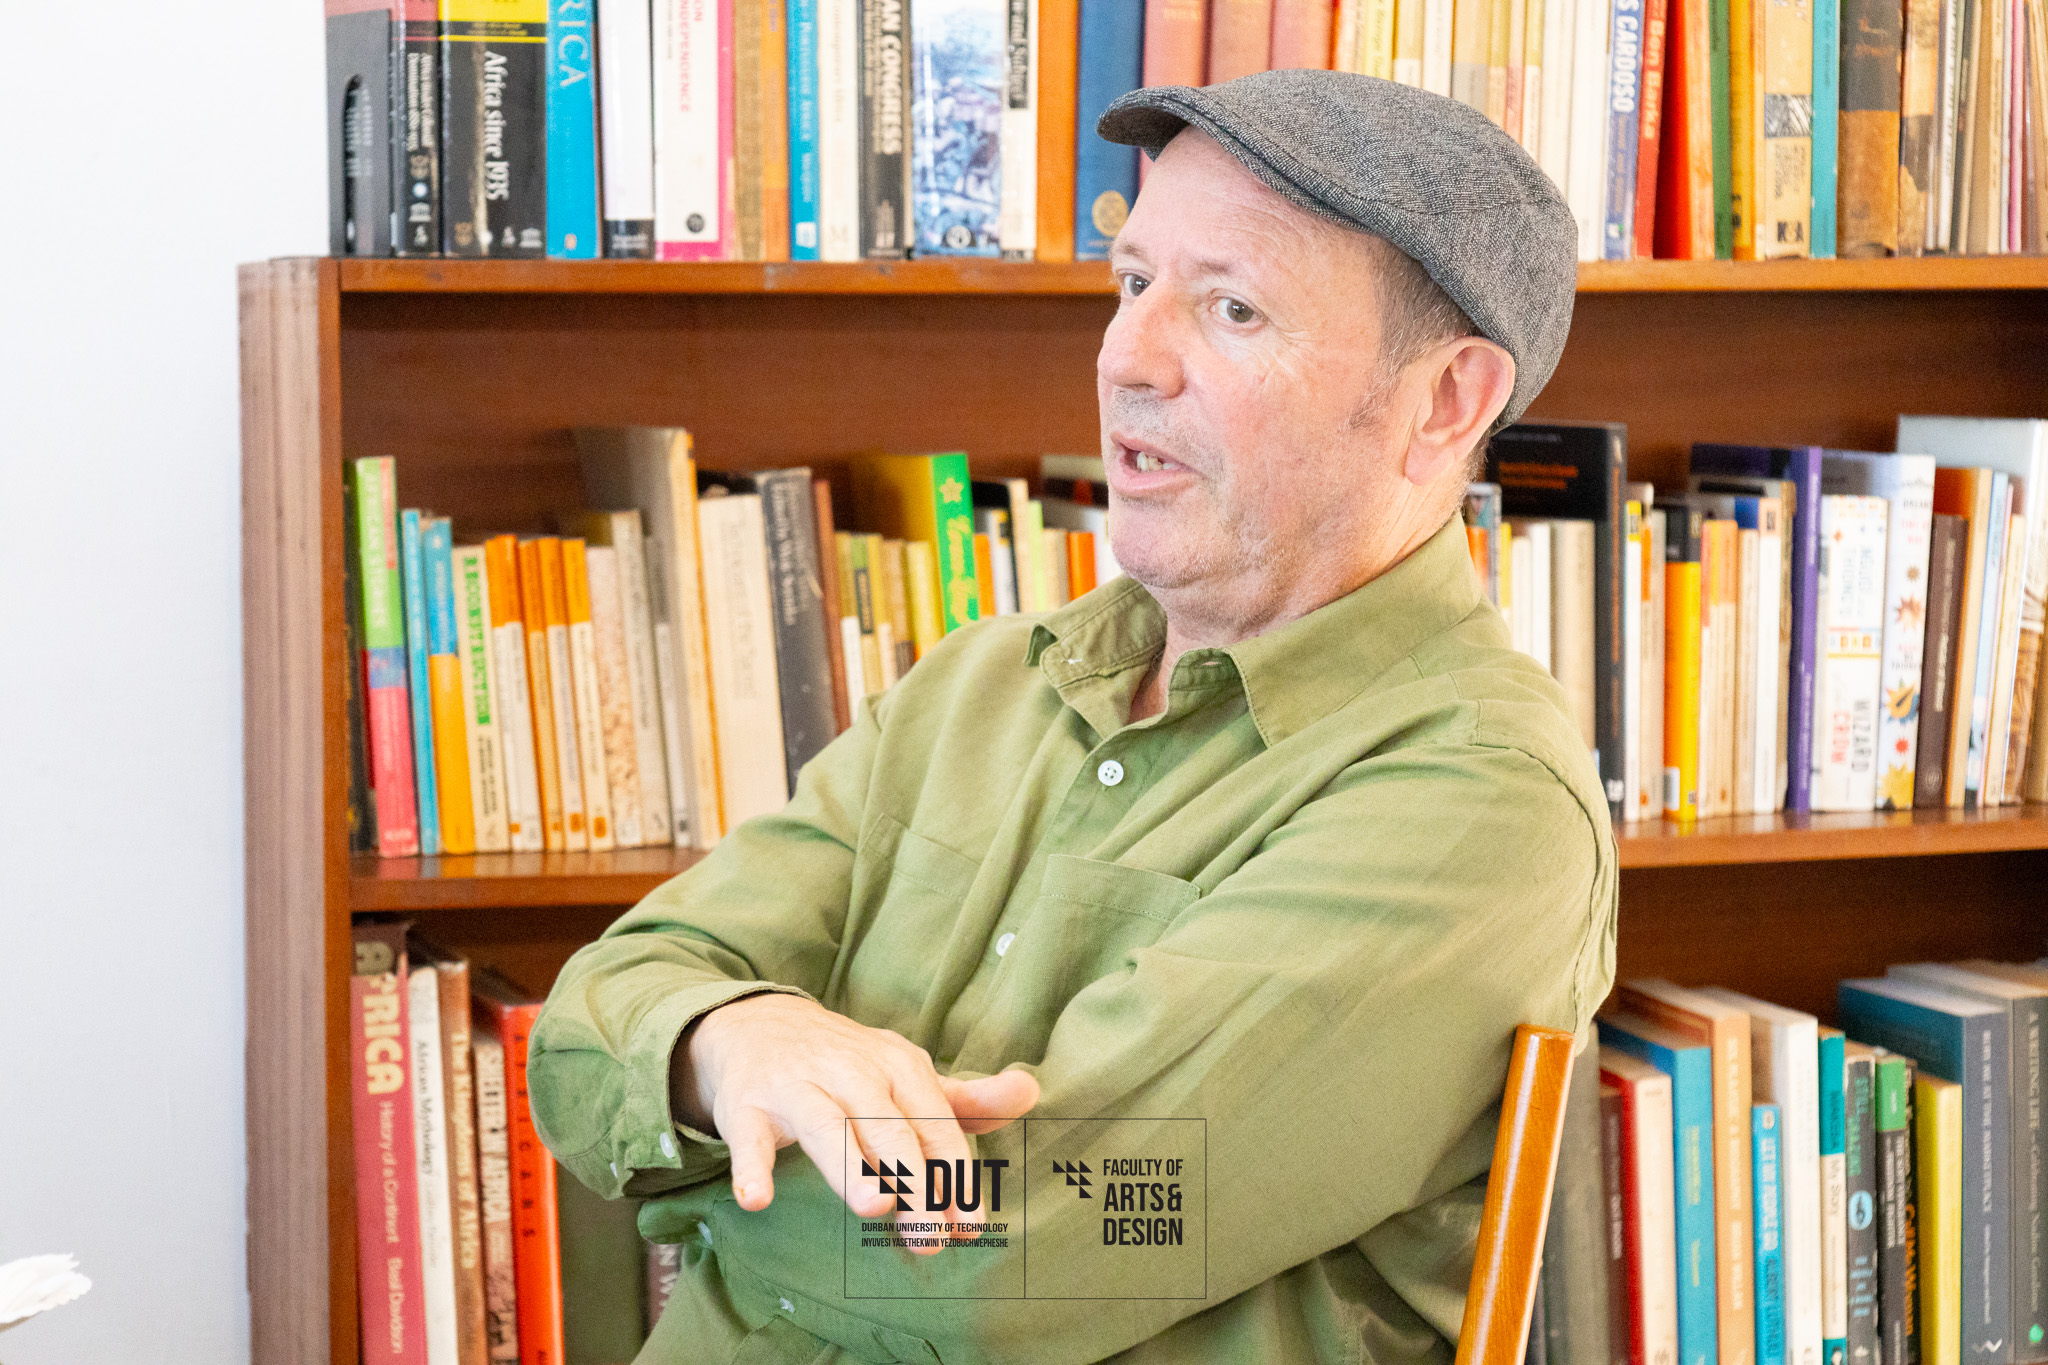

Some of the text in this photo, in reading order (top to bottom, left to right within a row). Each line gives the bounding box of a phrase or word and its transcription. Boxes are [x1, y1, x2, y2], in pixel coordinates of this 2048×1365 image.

[1611, 14, 1638, 113] CARDOSO
[483, 50, 510, 201] Africa since 1935
[1831, 710, 1851, 765] CROW
[1851, 699, 1872, 773] WIZARD
[417, 1040, 431, 1095] African
[419, 1096, 437, 1176] Mythology
